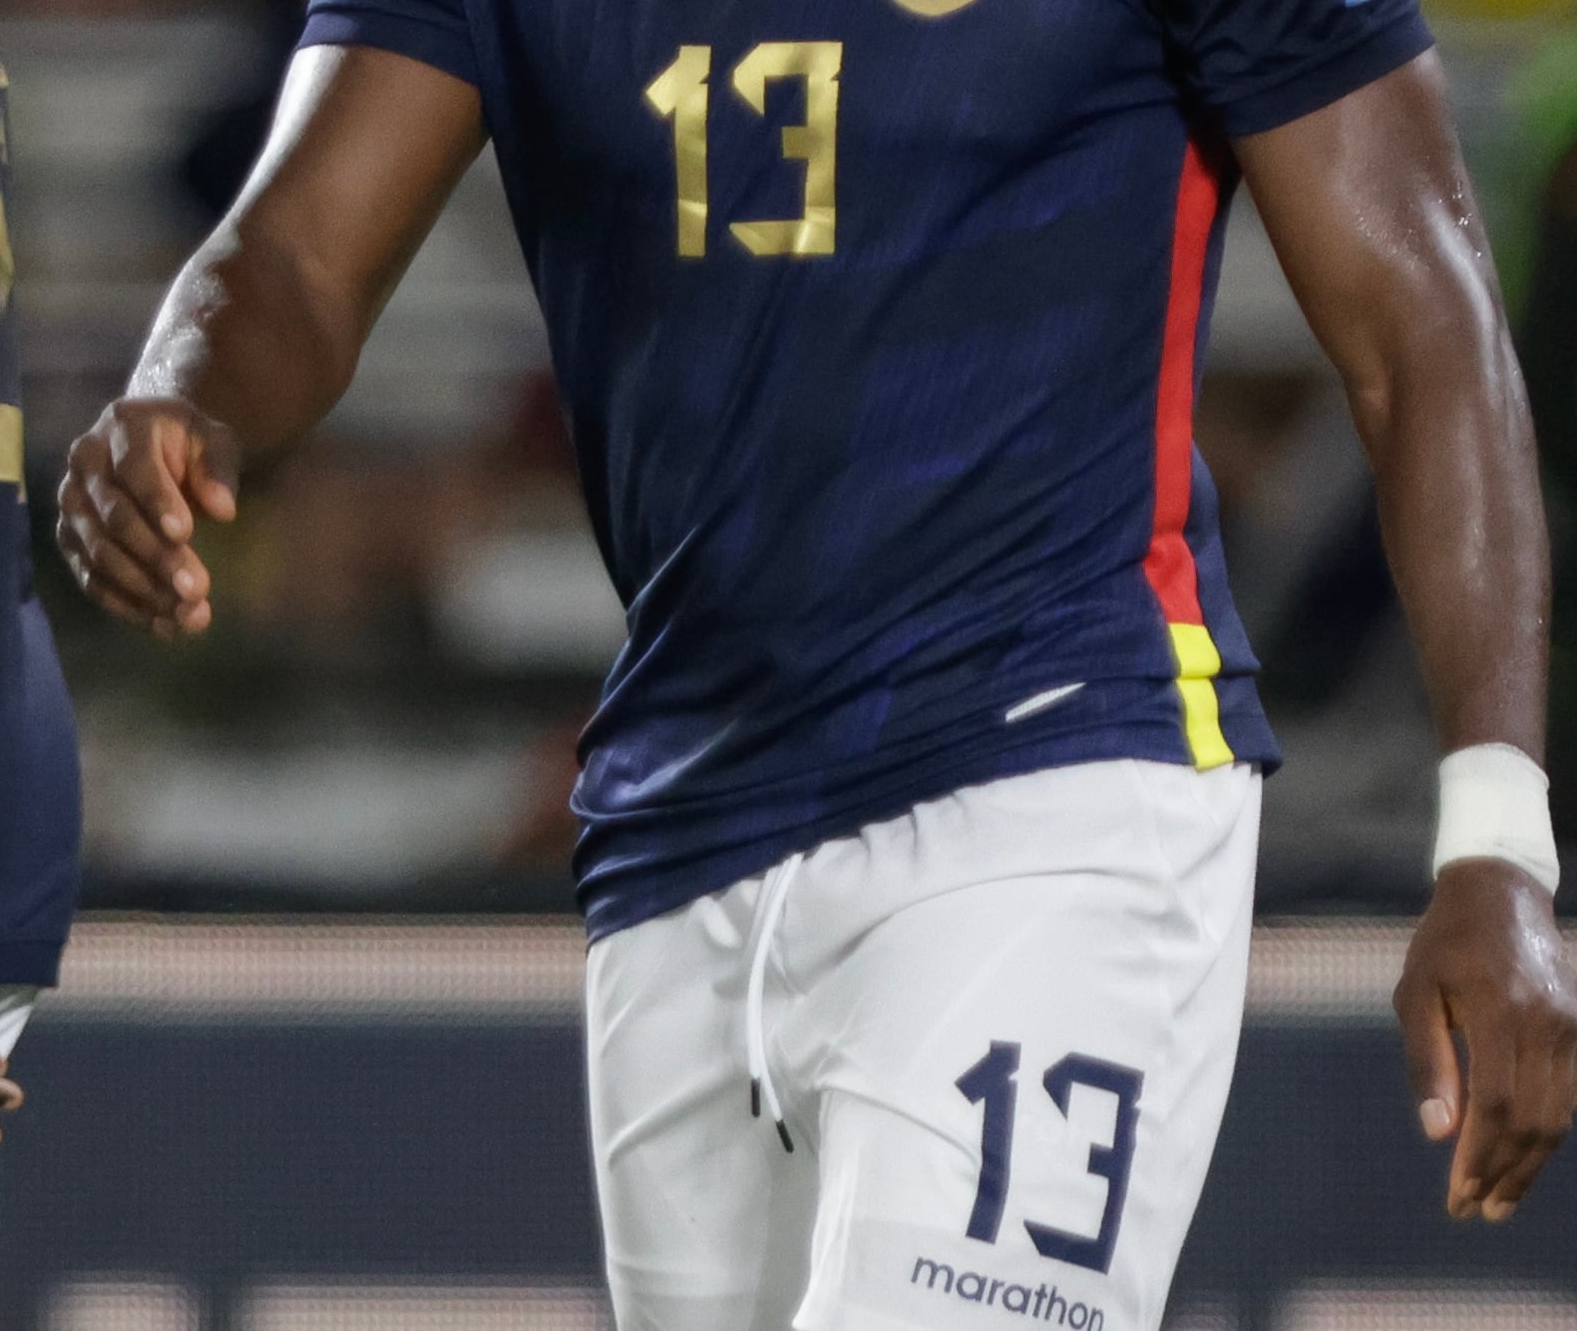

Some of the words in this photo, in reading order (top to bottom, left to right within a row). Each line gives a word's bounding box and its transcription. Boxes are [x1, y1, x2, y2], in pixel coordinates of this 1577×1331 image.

[644, 40, 843, 257] 13
[954, 1039, 1146, 1276] 13
[910, 1256, 1106, 1331] marathon
